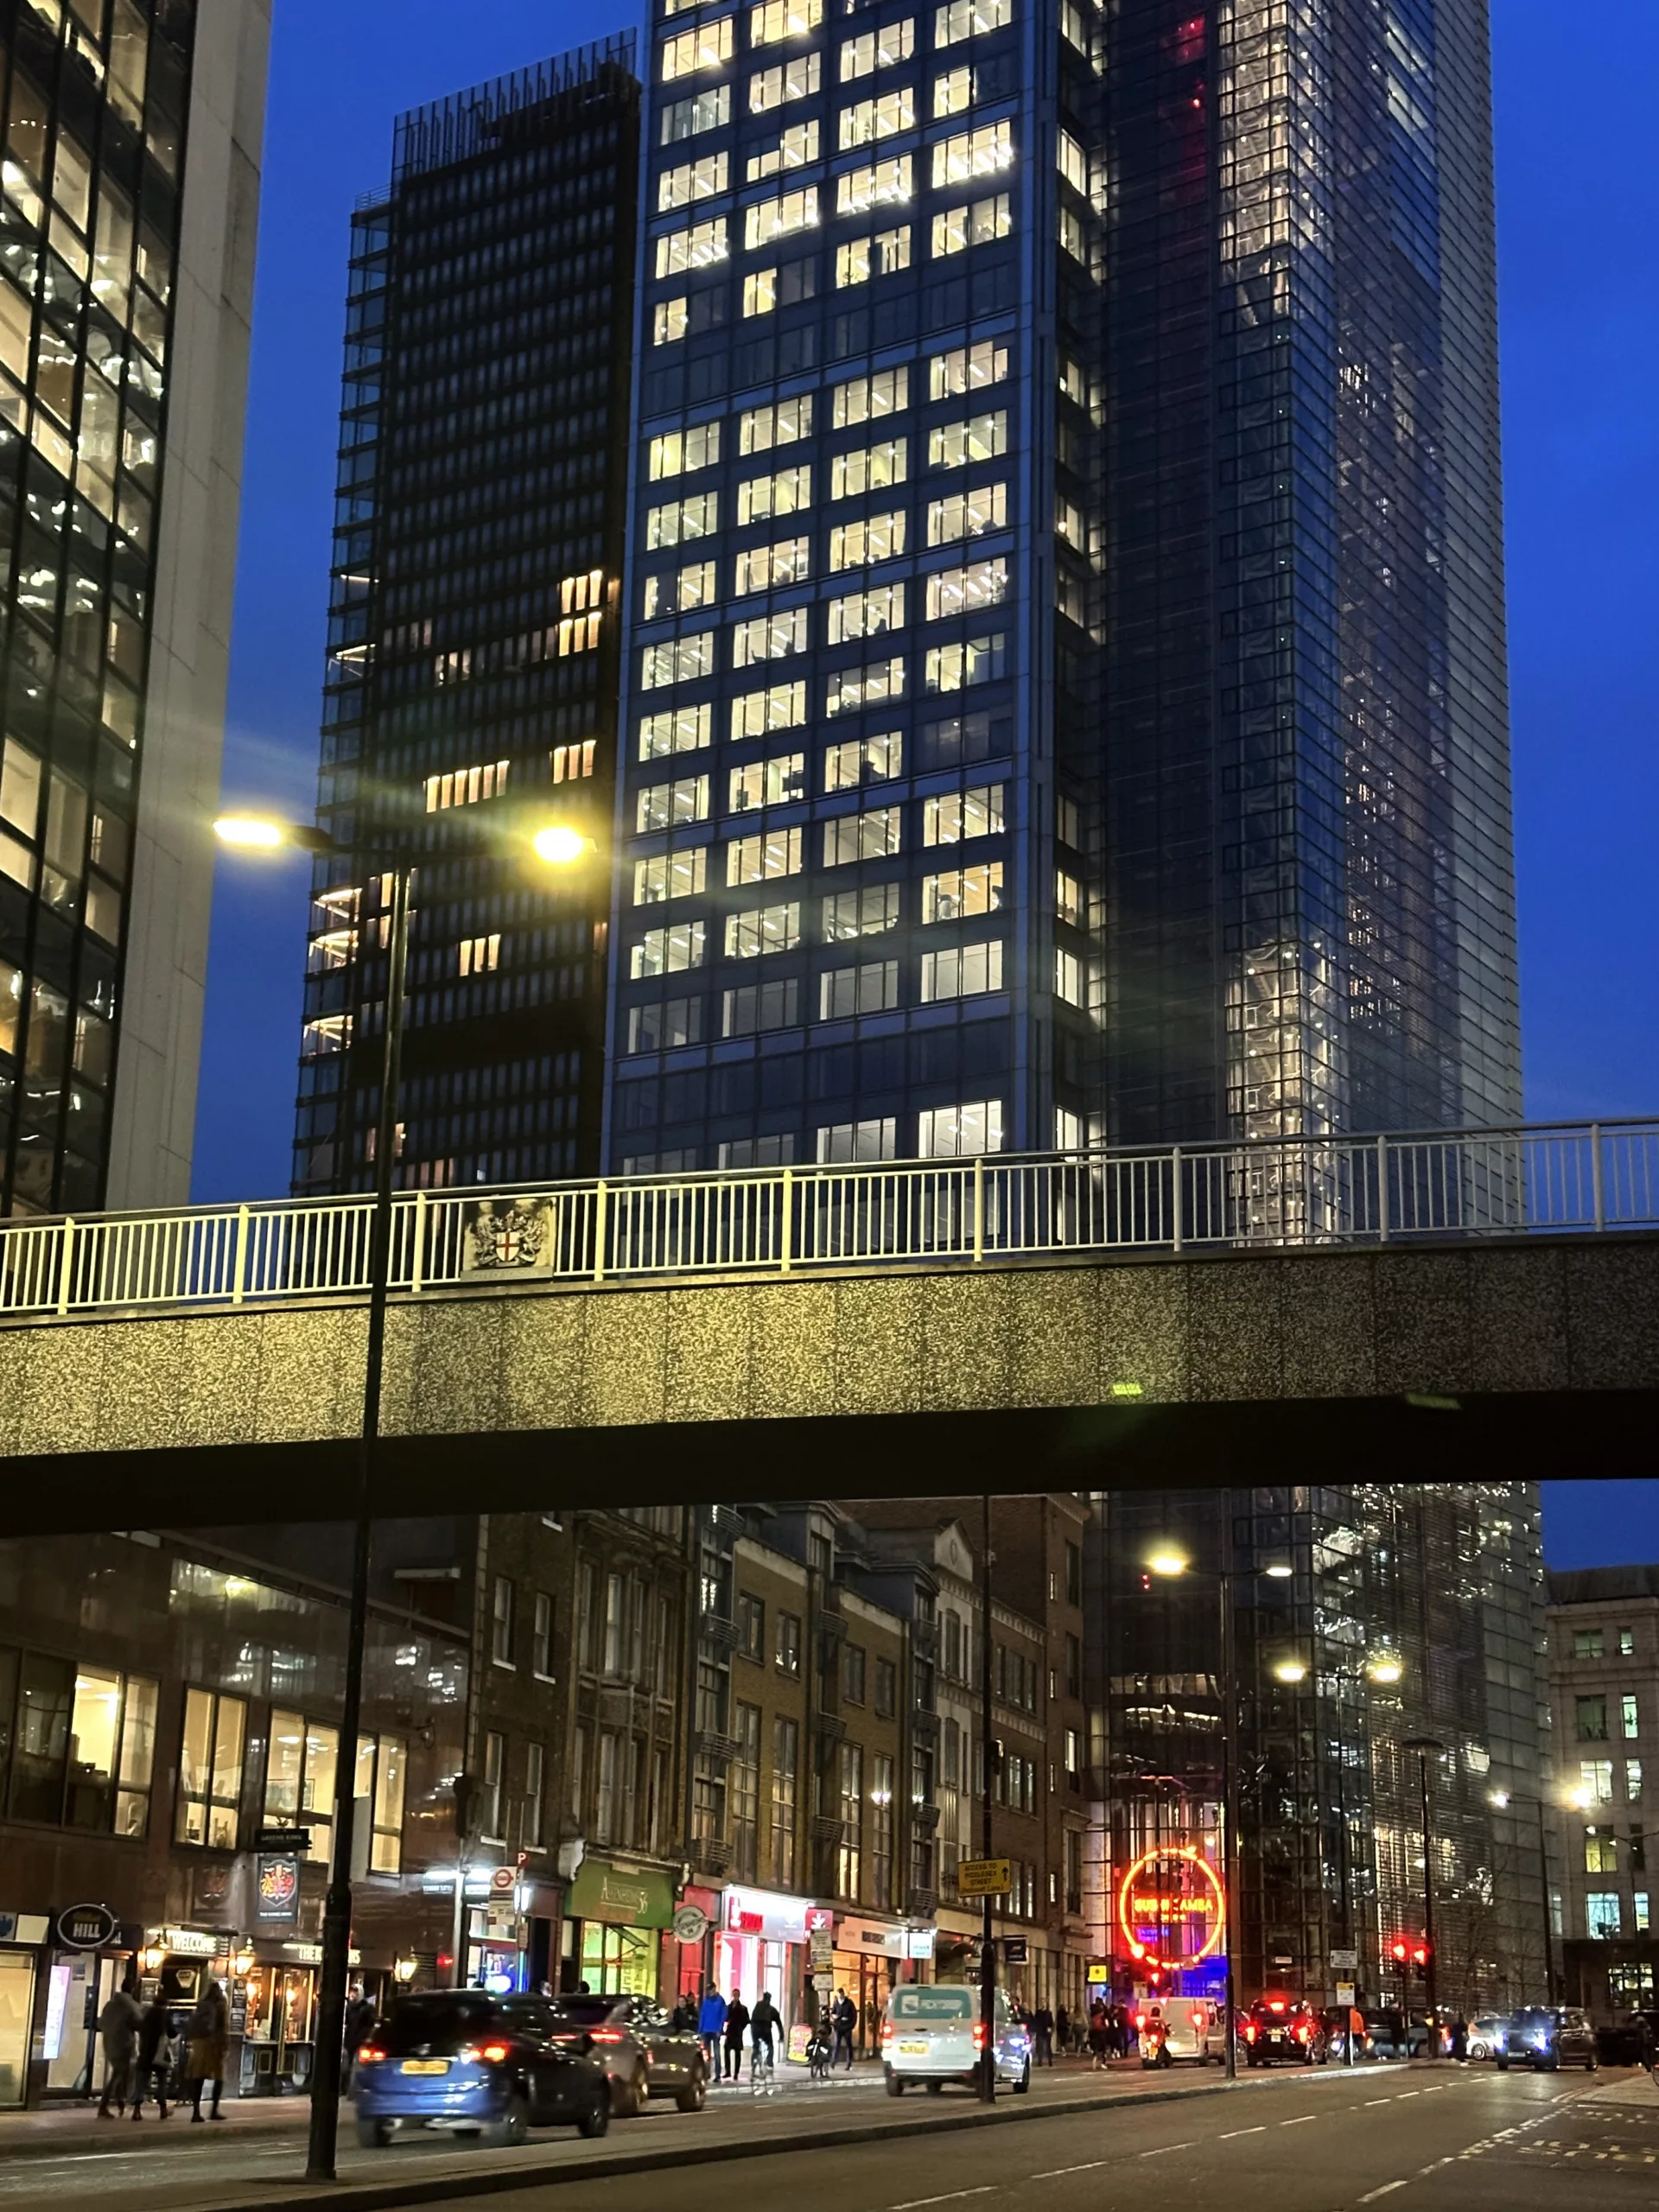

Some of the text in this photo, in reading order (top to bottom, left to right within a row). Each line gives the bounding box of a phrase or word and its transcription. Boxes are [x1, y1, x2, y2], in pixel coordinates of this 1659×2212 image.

[73, 1923, 101, 1939] HILL
[172, 1935, 217, 1953] WELCOME
[298, 1946, 315, 1961] THE
